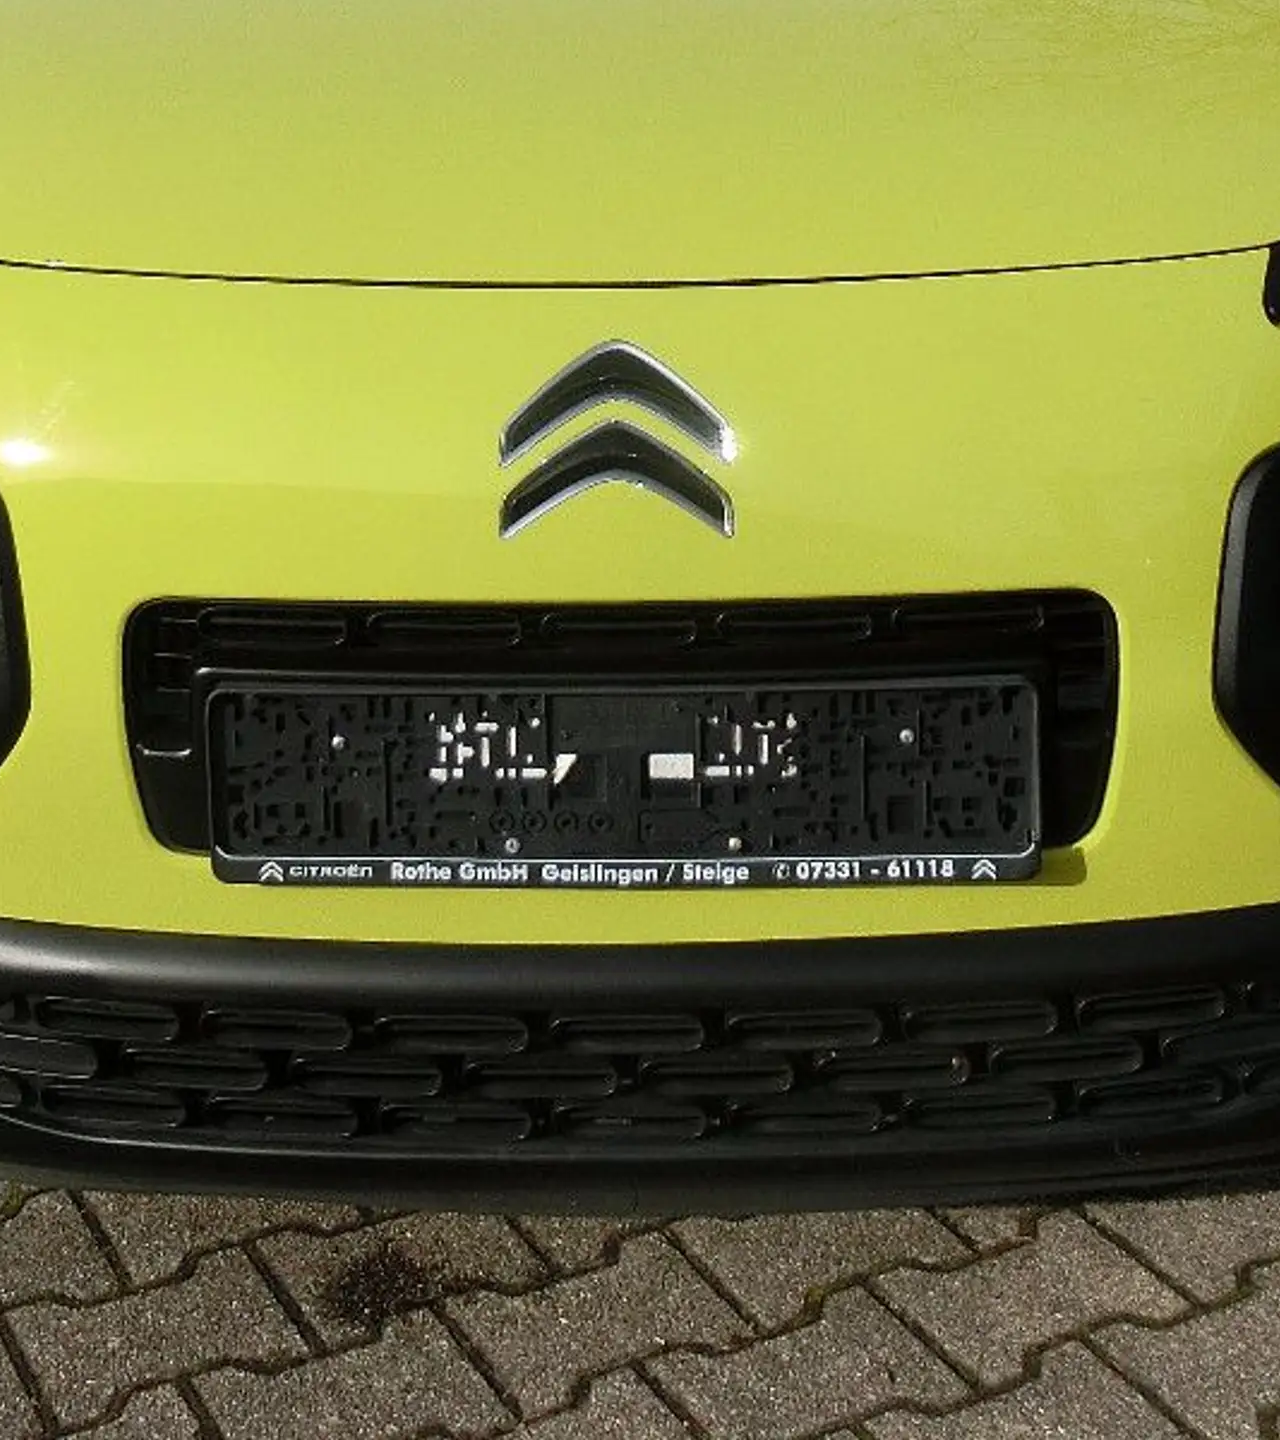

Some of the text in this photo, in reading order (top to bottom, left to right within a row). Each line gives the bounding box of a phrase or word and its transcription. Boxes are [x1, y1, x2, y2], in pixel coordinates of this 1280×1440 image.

[391, 861, 452, 880] Rothe
[459, 861, 528, 880] GmbH
[541, 863, 658, 884] Geislingen
[665, 863, 675, 883] /
[683, 862, 749, 884] Steige
[796, 861, 860, 880] 07331
[887, 859, 954, 878] 61118
